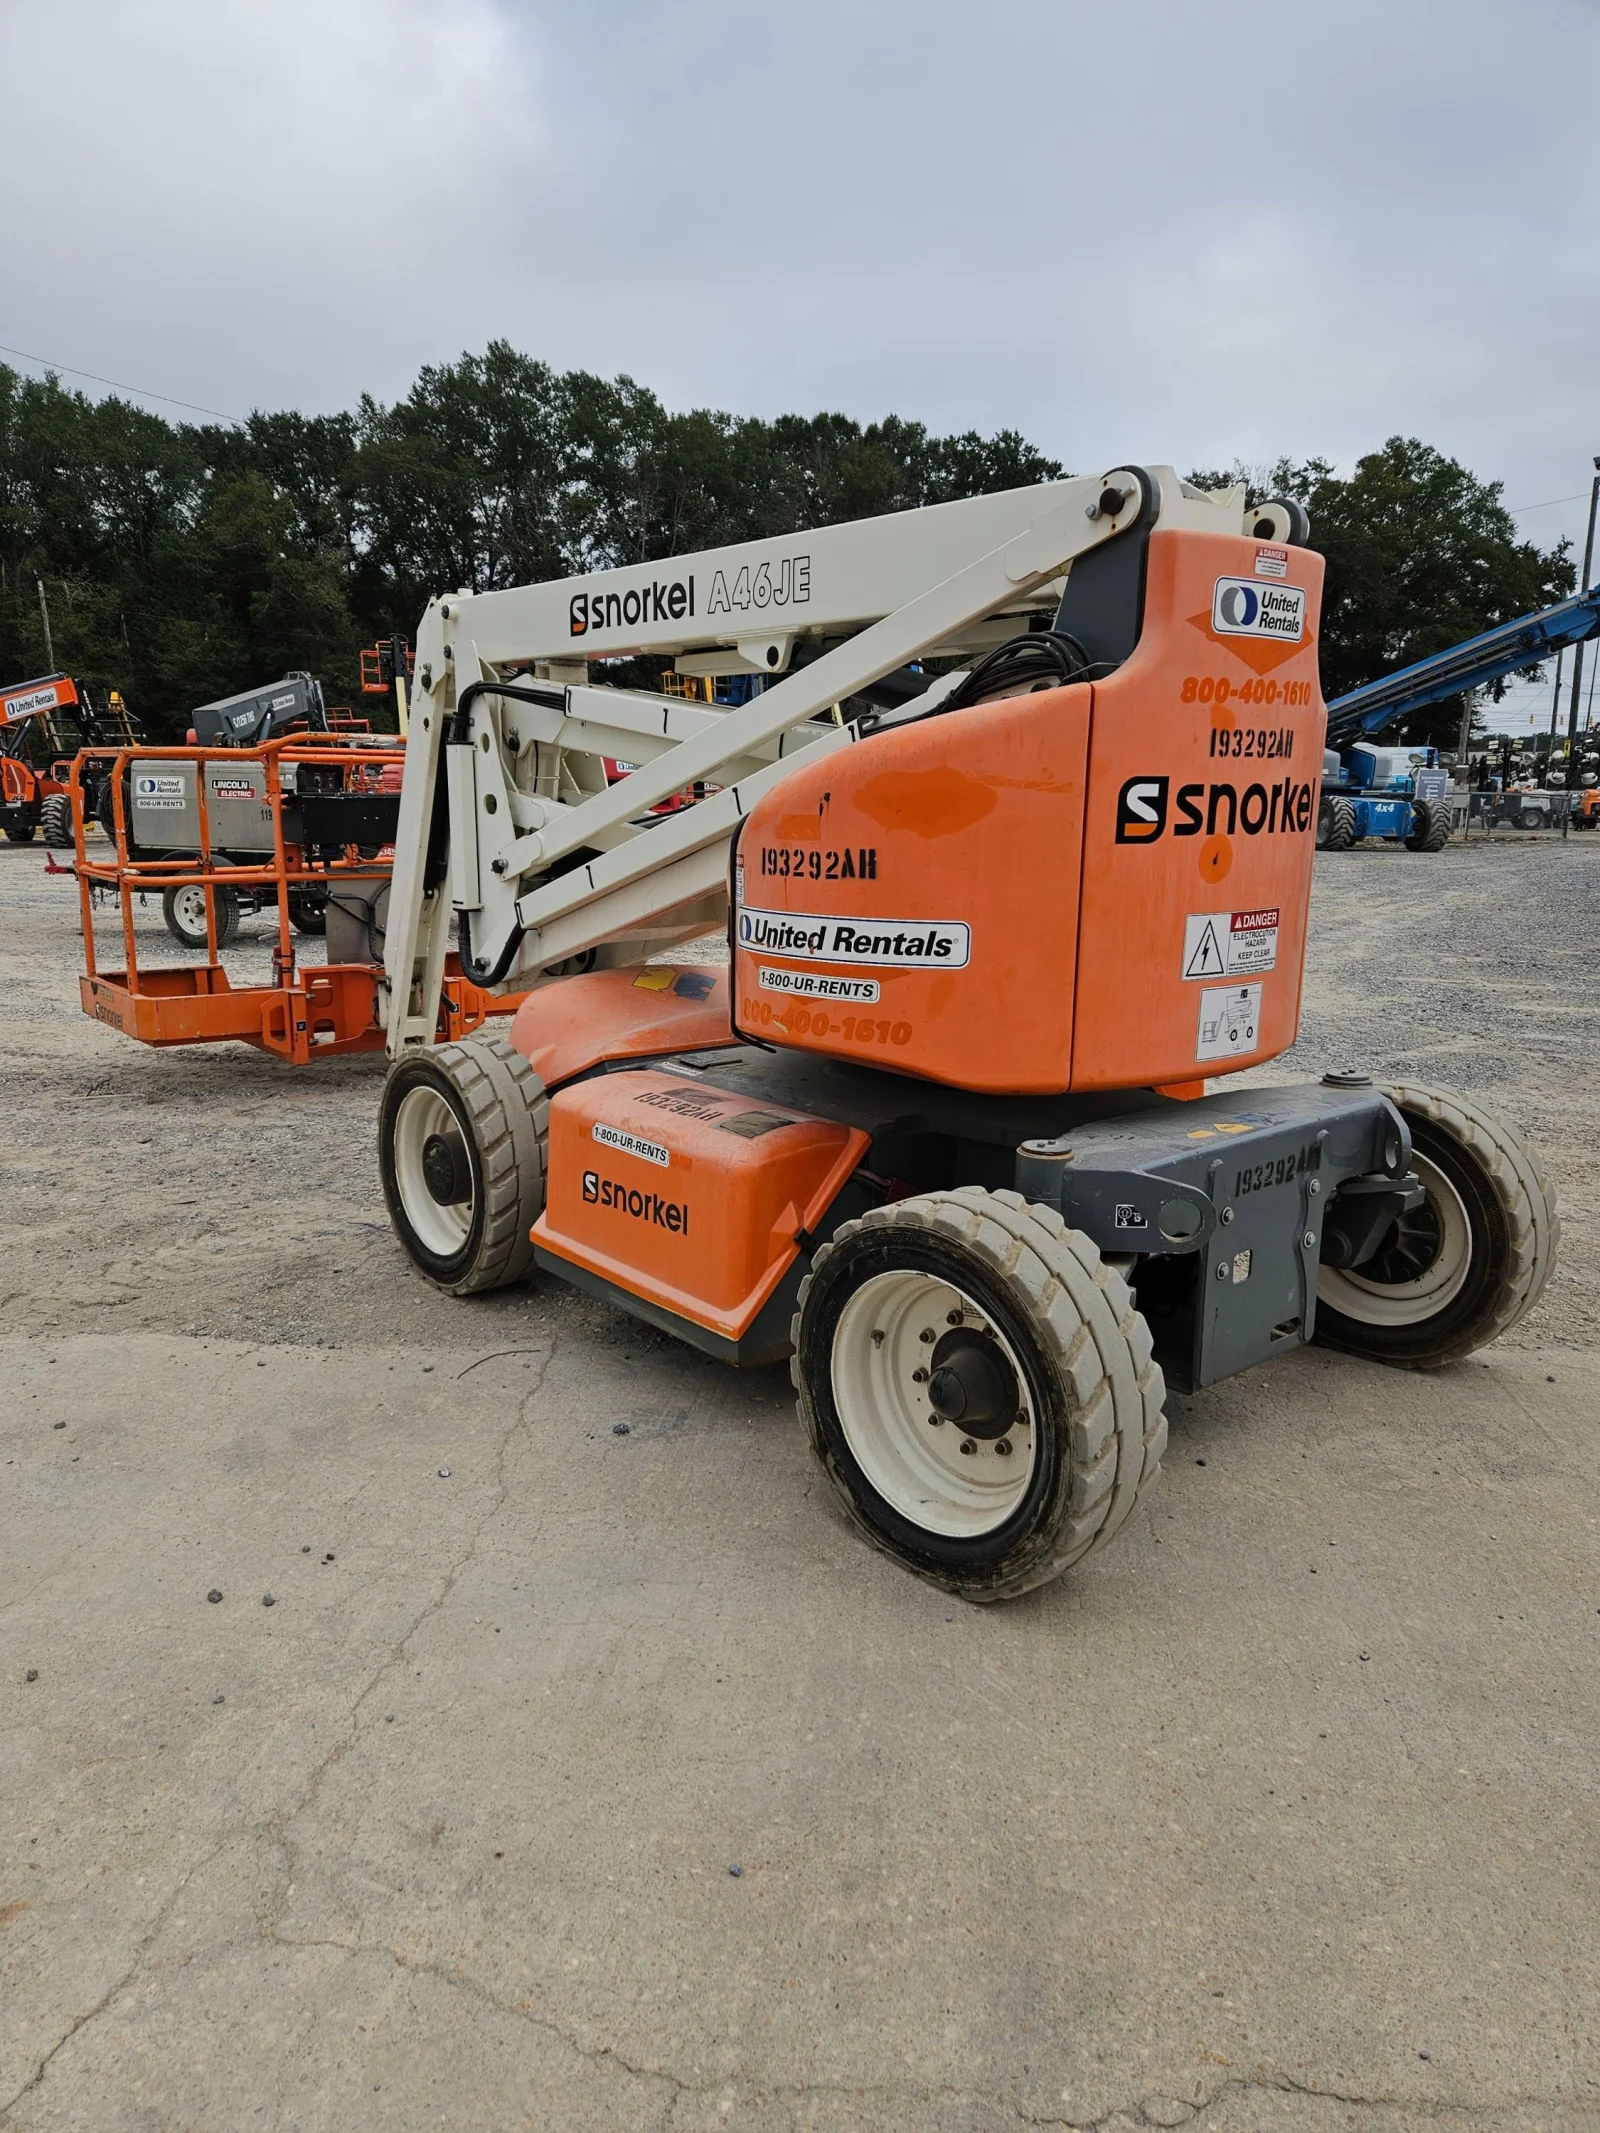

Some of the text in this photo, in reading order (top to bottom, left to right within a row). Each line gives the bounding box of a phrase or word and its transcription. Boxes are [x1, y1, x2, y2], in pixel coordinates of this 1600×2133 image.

[1264, 549, 1286, 560] DANGER
[592, 556, 810, 629] snorkel A46JE
[1261, 591, 1300, 613] United
[1258, 610, 1300, 634] Rentals
[1180, 677, 1310, 705] 800-400-1610
[16, 693, 54, 712] United Rentals
[213, 781, 248, 789] LINCOLN
[1174, 777, 1316, 836] snorkel
[1374, 804, 1395, 812] 4x4
[1243, 912, 1277, 927] DANGER
[754, 918, 953, 958] United Rentals
[1234, 929, 1276, 940] ELECTROCUTION
[1245, 938, 1266, 947] HAZARD
[1238, 949, 1270, 960] KEEP CLEAR
[760, 972, 874, 998] 1-800-UR-RENTS
[594, 1126, 667, 1162] 1-800-UR-RENTS
[601, 1182, 688, 1236] snorkel
